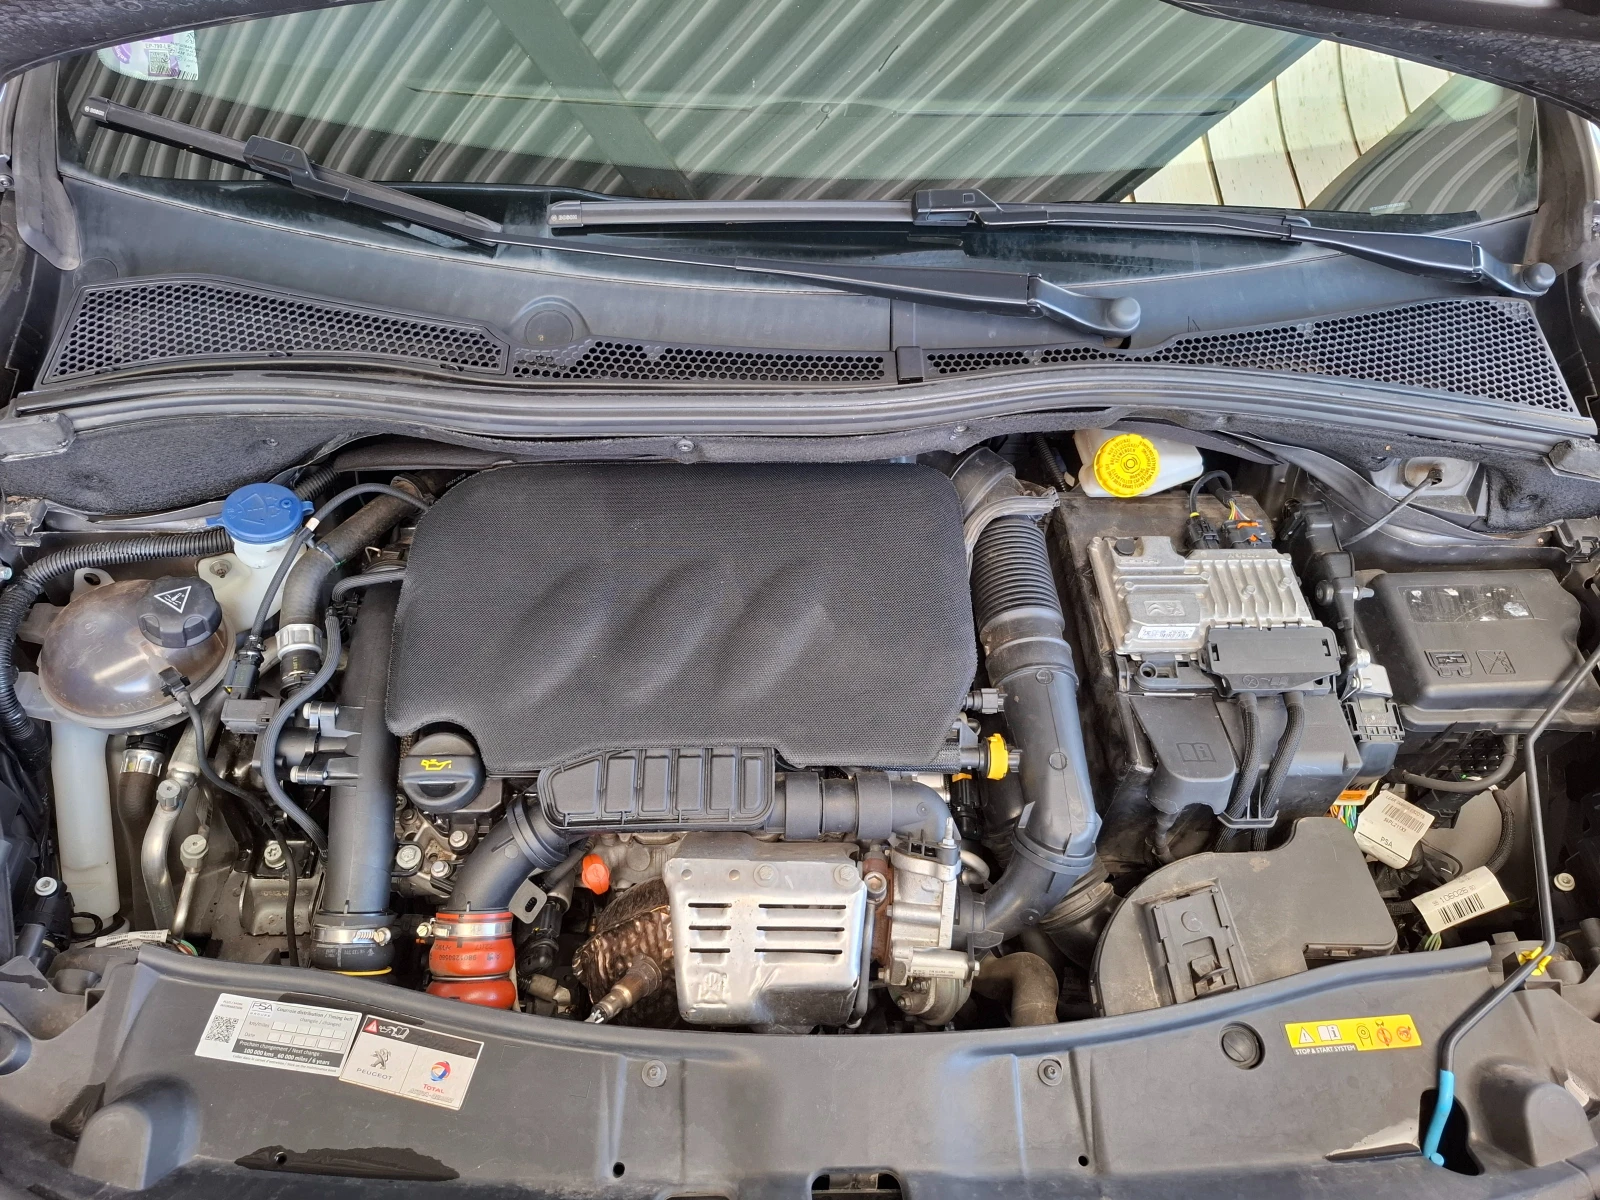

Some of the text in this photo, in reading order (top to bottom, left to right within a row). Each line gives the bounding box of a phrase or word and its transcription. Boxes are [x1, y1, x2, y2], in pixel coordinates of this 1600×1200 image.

[1380, 836, 1393, 848] PSA
[252, 1002, 274, 1011] PSA
[260, 1044, 288, 1052] changement
[356, 1068, 393, 1081] PEUGEOT
[422, 1084, 445, 1094] TOTAL
